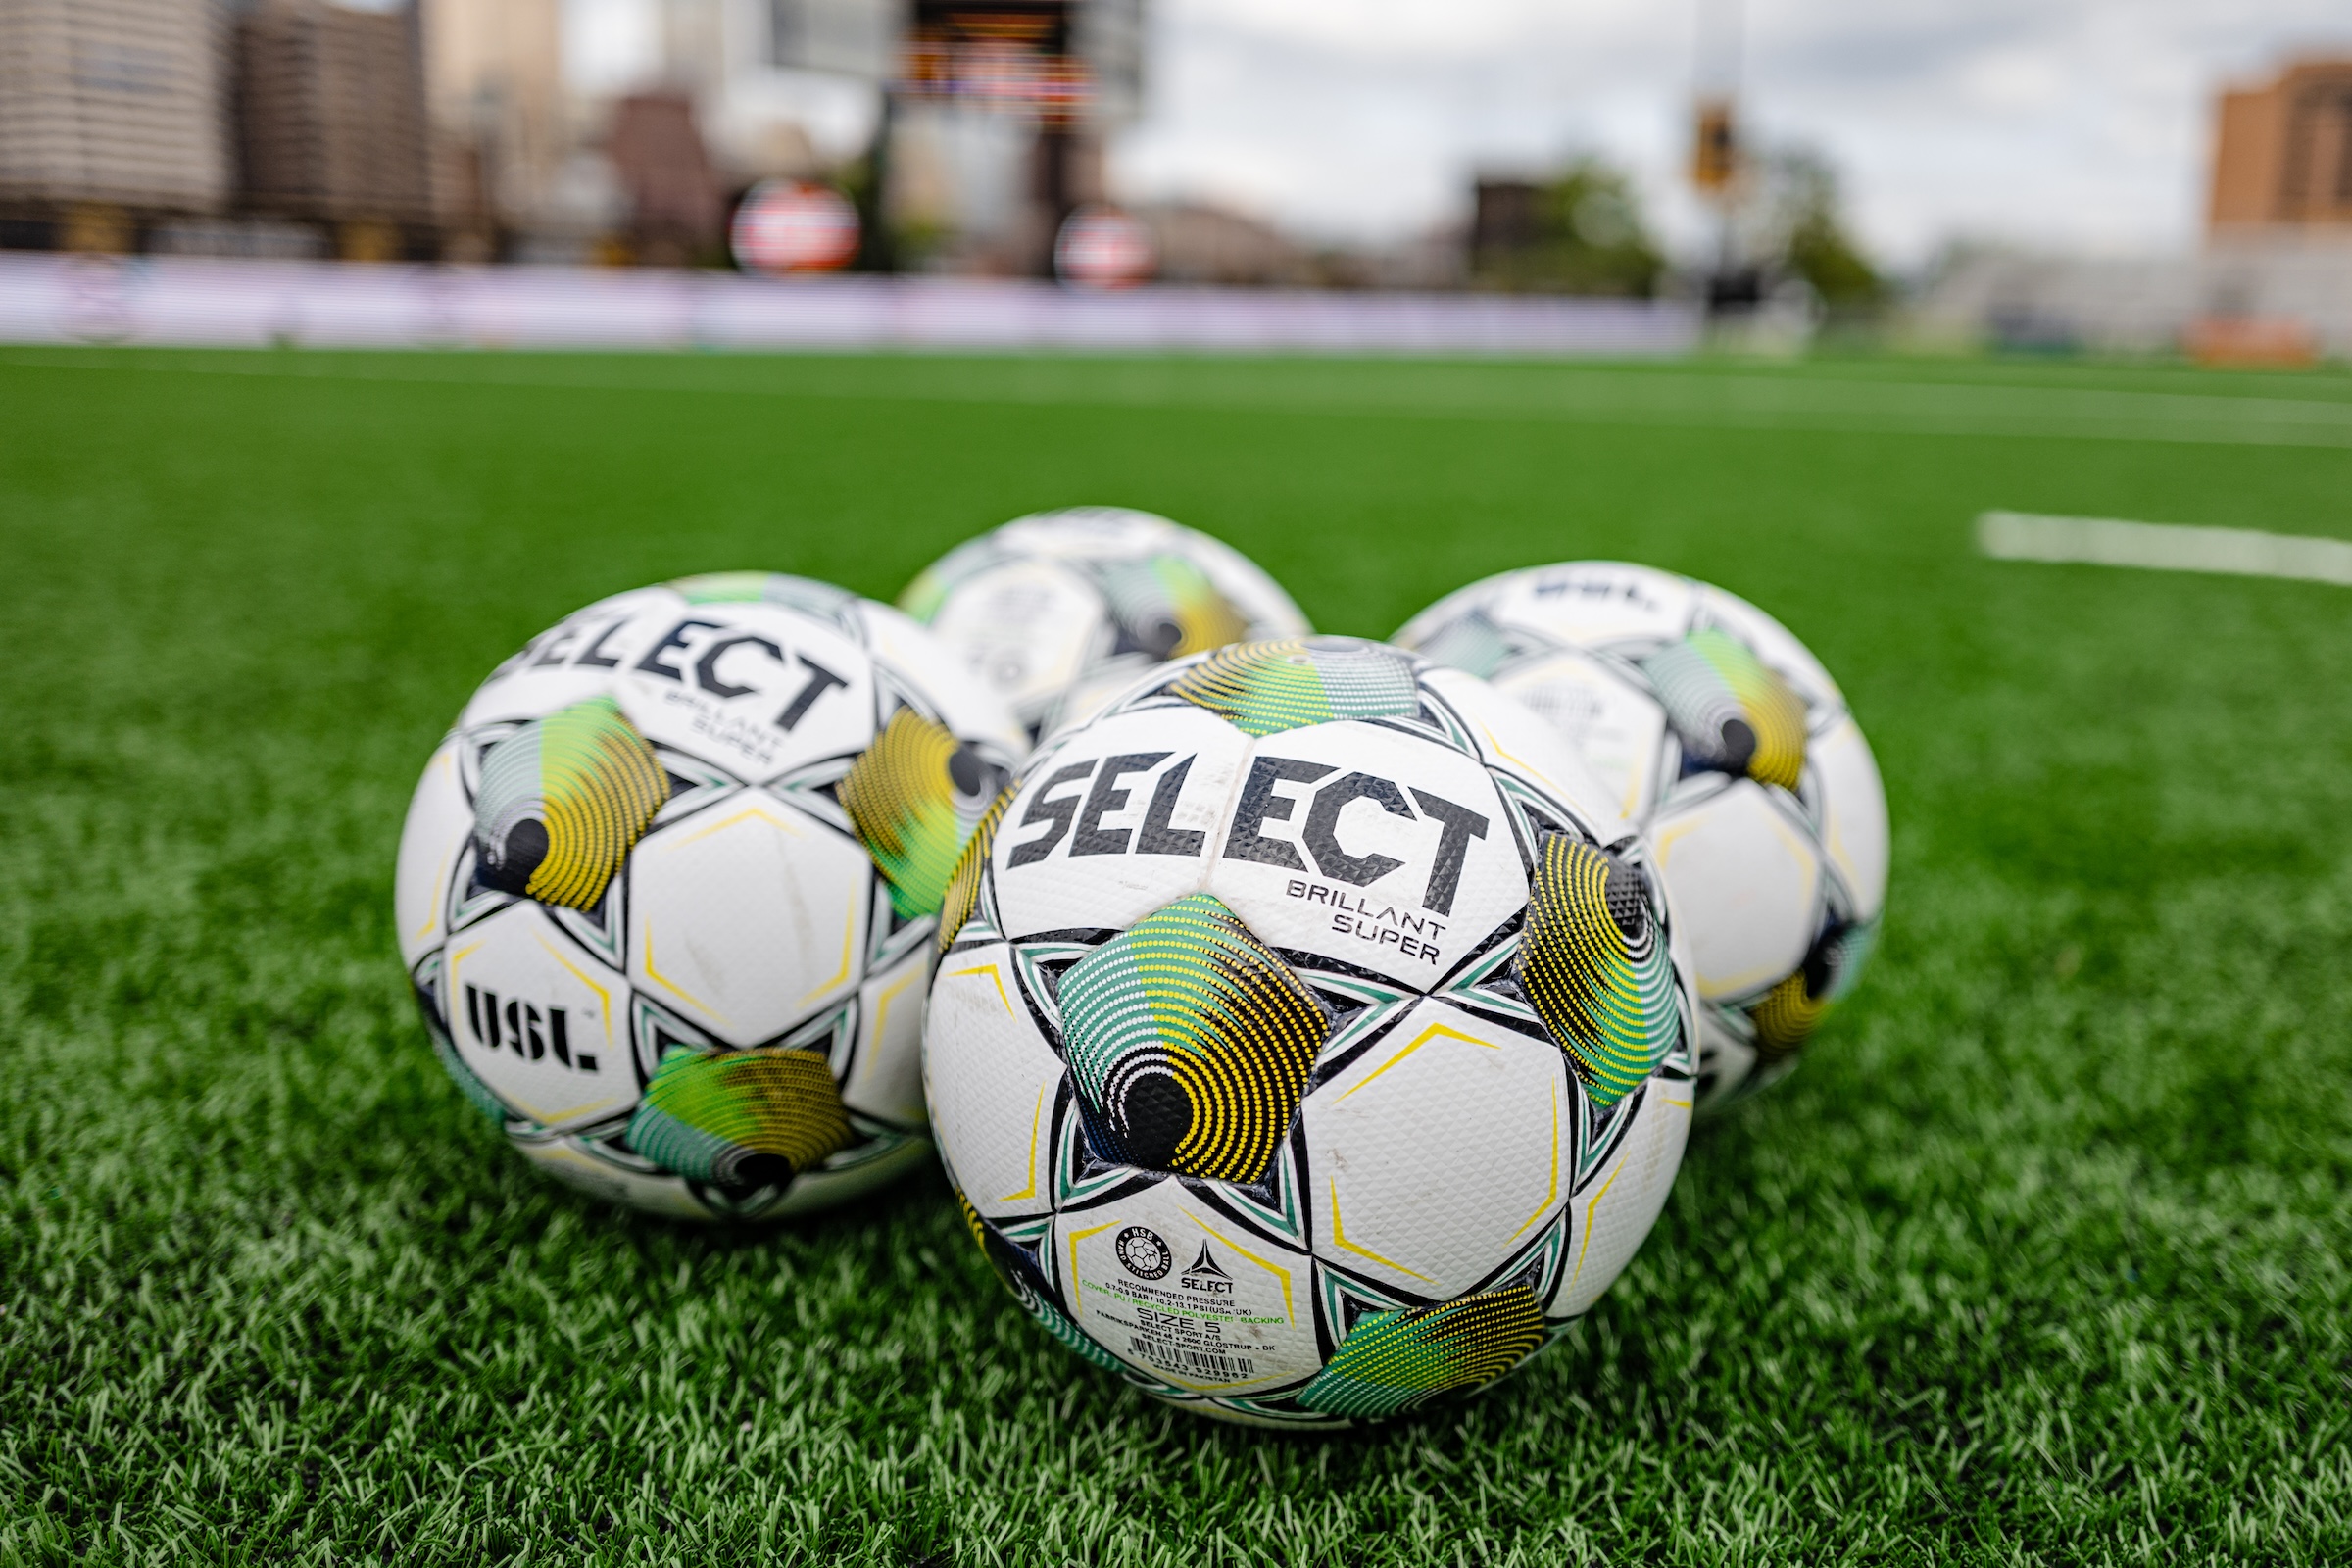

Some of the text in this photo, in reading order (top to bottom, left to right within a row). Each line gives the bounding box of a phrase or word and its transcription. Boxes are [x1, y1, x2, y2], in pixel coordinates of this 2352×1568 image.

[1006, 751, 1489, 917] SELECT
[1286, 880, 1446, 939] BRILLANT
[1332, 914, 1440, 965] SUPER
[1132, 1228, 1153, 1240] HSB
[1118, 1240, 1170, 1278] HAND STITCHED BALL
[1082, 1279, 1112, 1296] COVER:
[1114, 1293, 1126, 1302] PU
[1132, 1298, 1180, 1315] RECYCLED
[1105, 1282, 1130, 1296] 0.7-0.9
[1132, 1292, 1149, 1300] BAR
[1155, 1298, 1191, 1310] 10.2-13.1
[1118, 1278, 1235, 1306] RECOMMENDED PRESSURE
[1181, 1277, 1233, 1294] SELECT
[1096, 1309, 1162, 1337] FABRIKSPARKEN
[1203, 1340, 1252, 1350] GLOSTRUP
[1137, 1307, 1221, 1334] SIZE 5
[1140, 1319, 1172, 1332] SELECT
[1174, 1328, 1203, 1338] SPORT
[1142, 1333, 1226, 1354] SELECT-SPORT.COM
[1153, 1364, 1176, 1374] MADE
[1189, 1373, 1231, 1383] PAKISTAN
